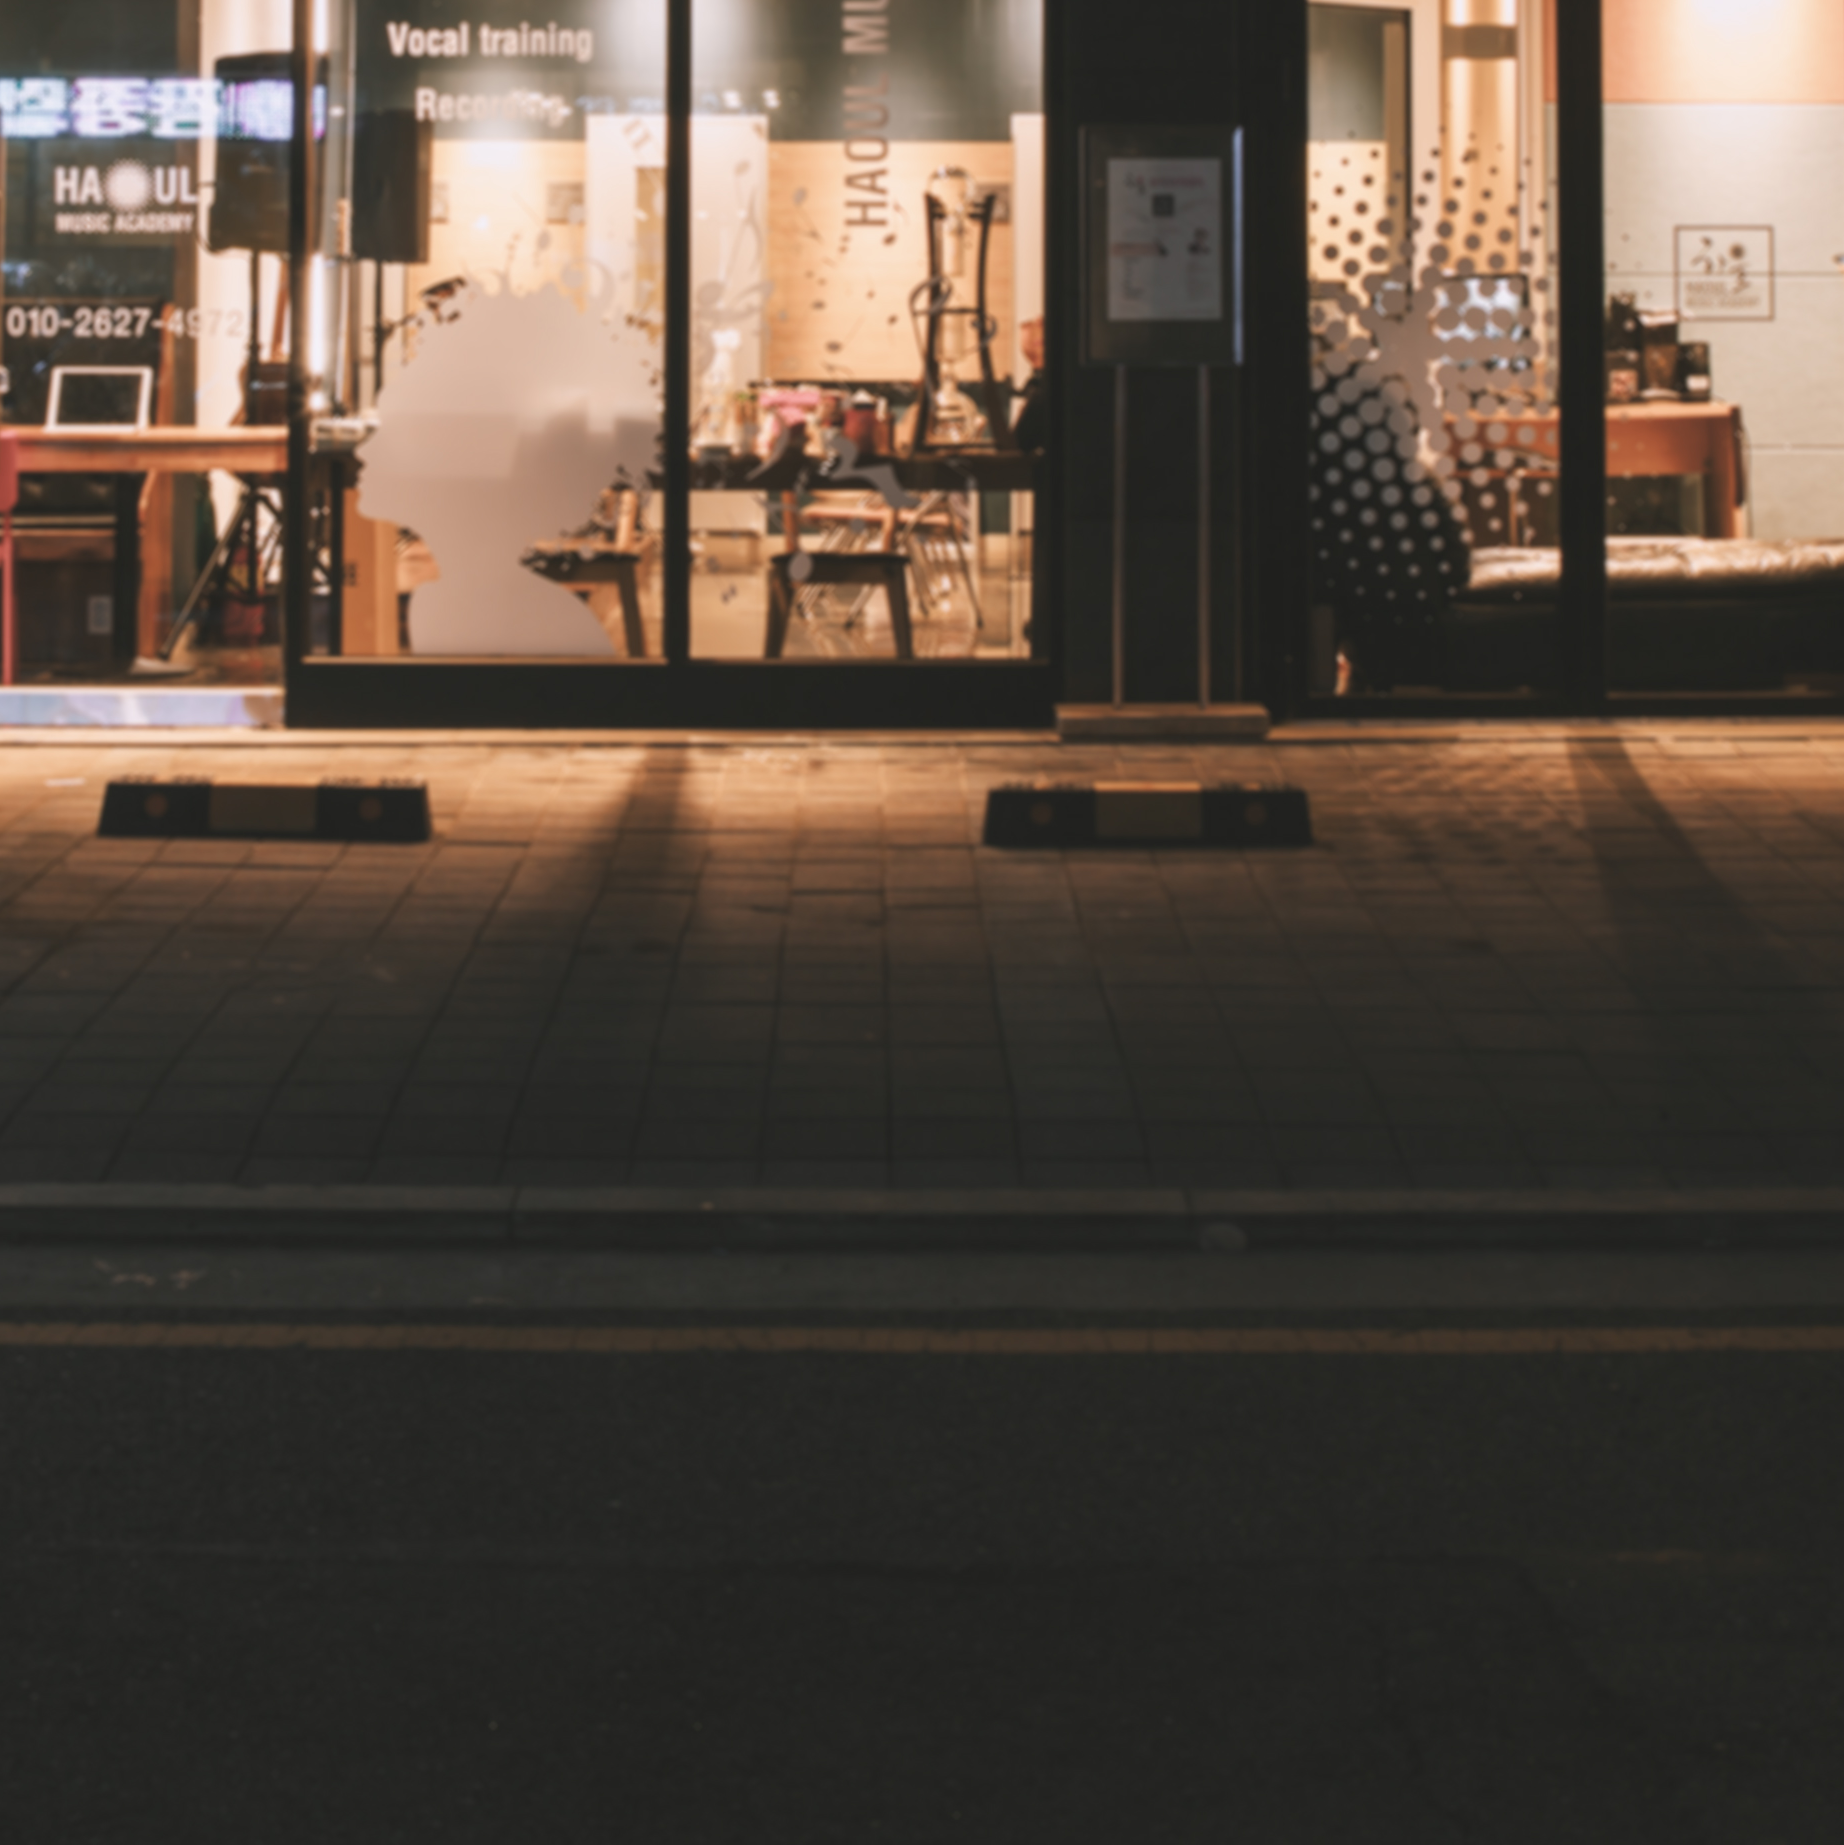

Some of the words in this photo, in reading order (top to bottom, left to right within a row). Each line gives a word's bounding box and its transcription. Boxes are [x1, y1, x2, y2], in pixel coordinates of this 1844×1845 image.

[387, 22, 469, 57] Vocal
[479, 22, 594, 63] training
[843, 72, 891, 229] HAOUL
[55, 213, 111, 235] MUSIC
[114, 212, 195, 235] ACADEMY
[6, 305, 244, 338] 010-2627-4972
